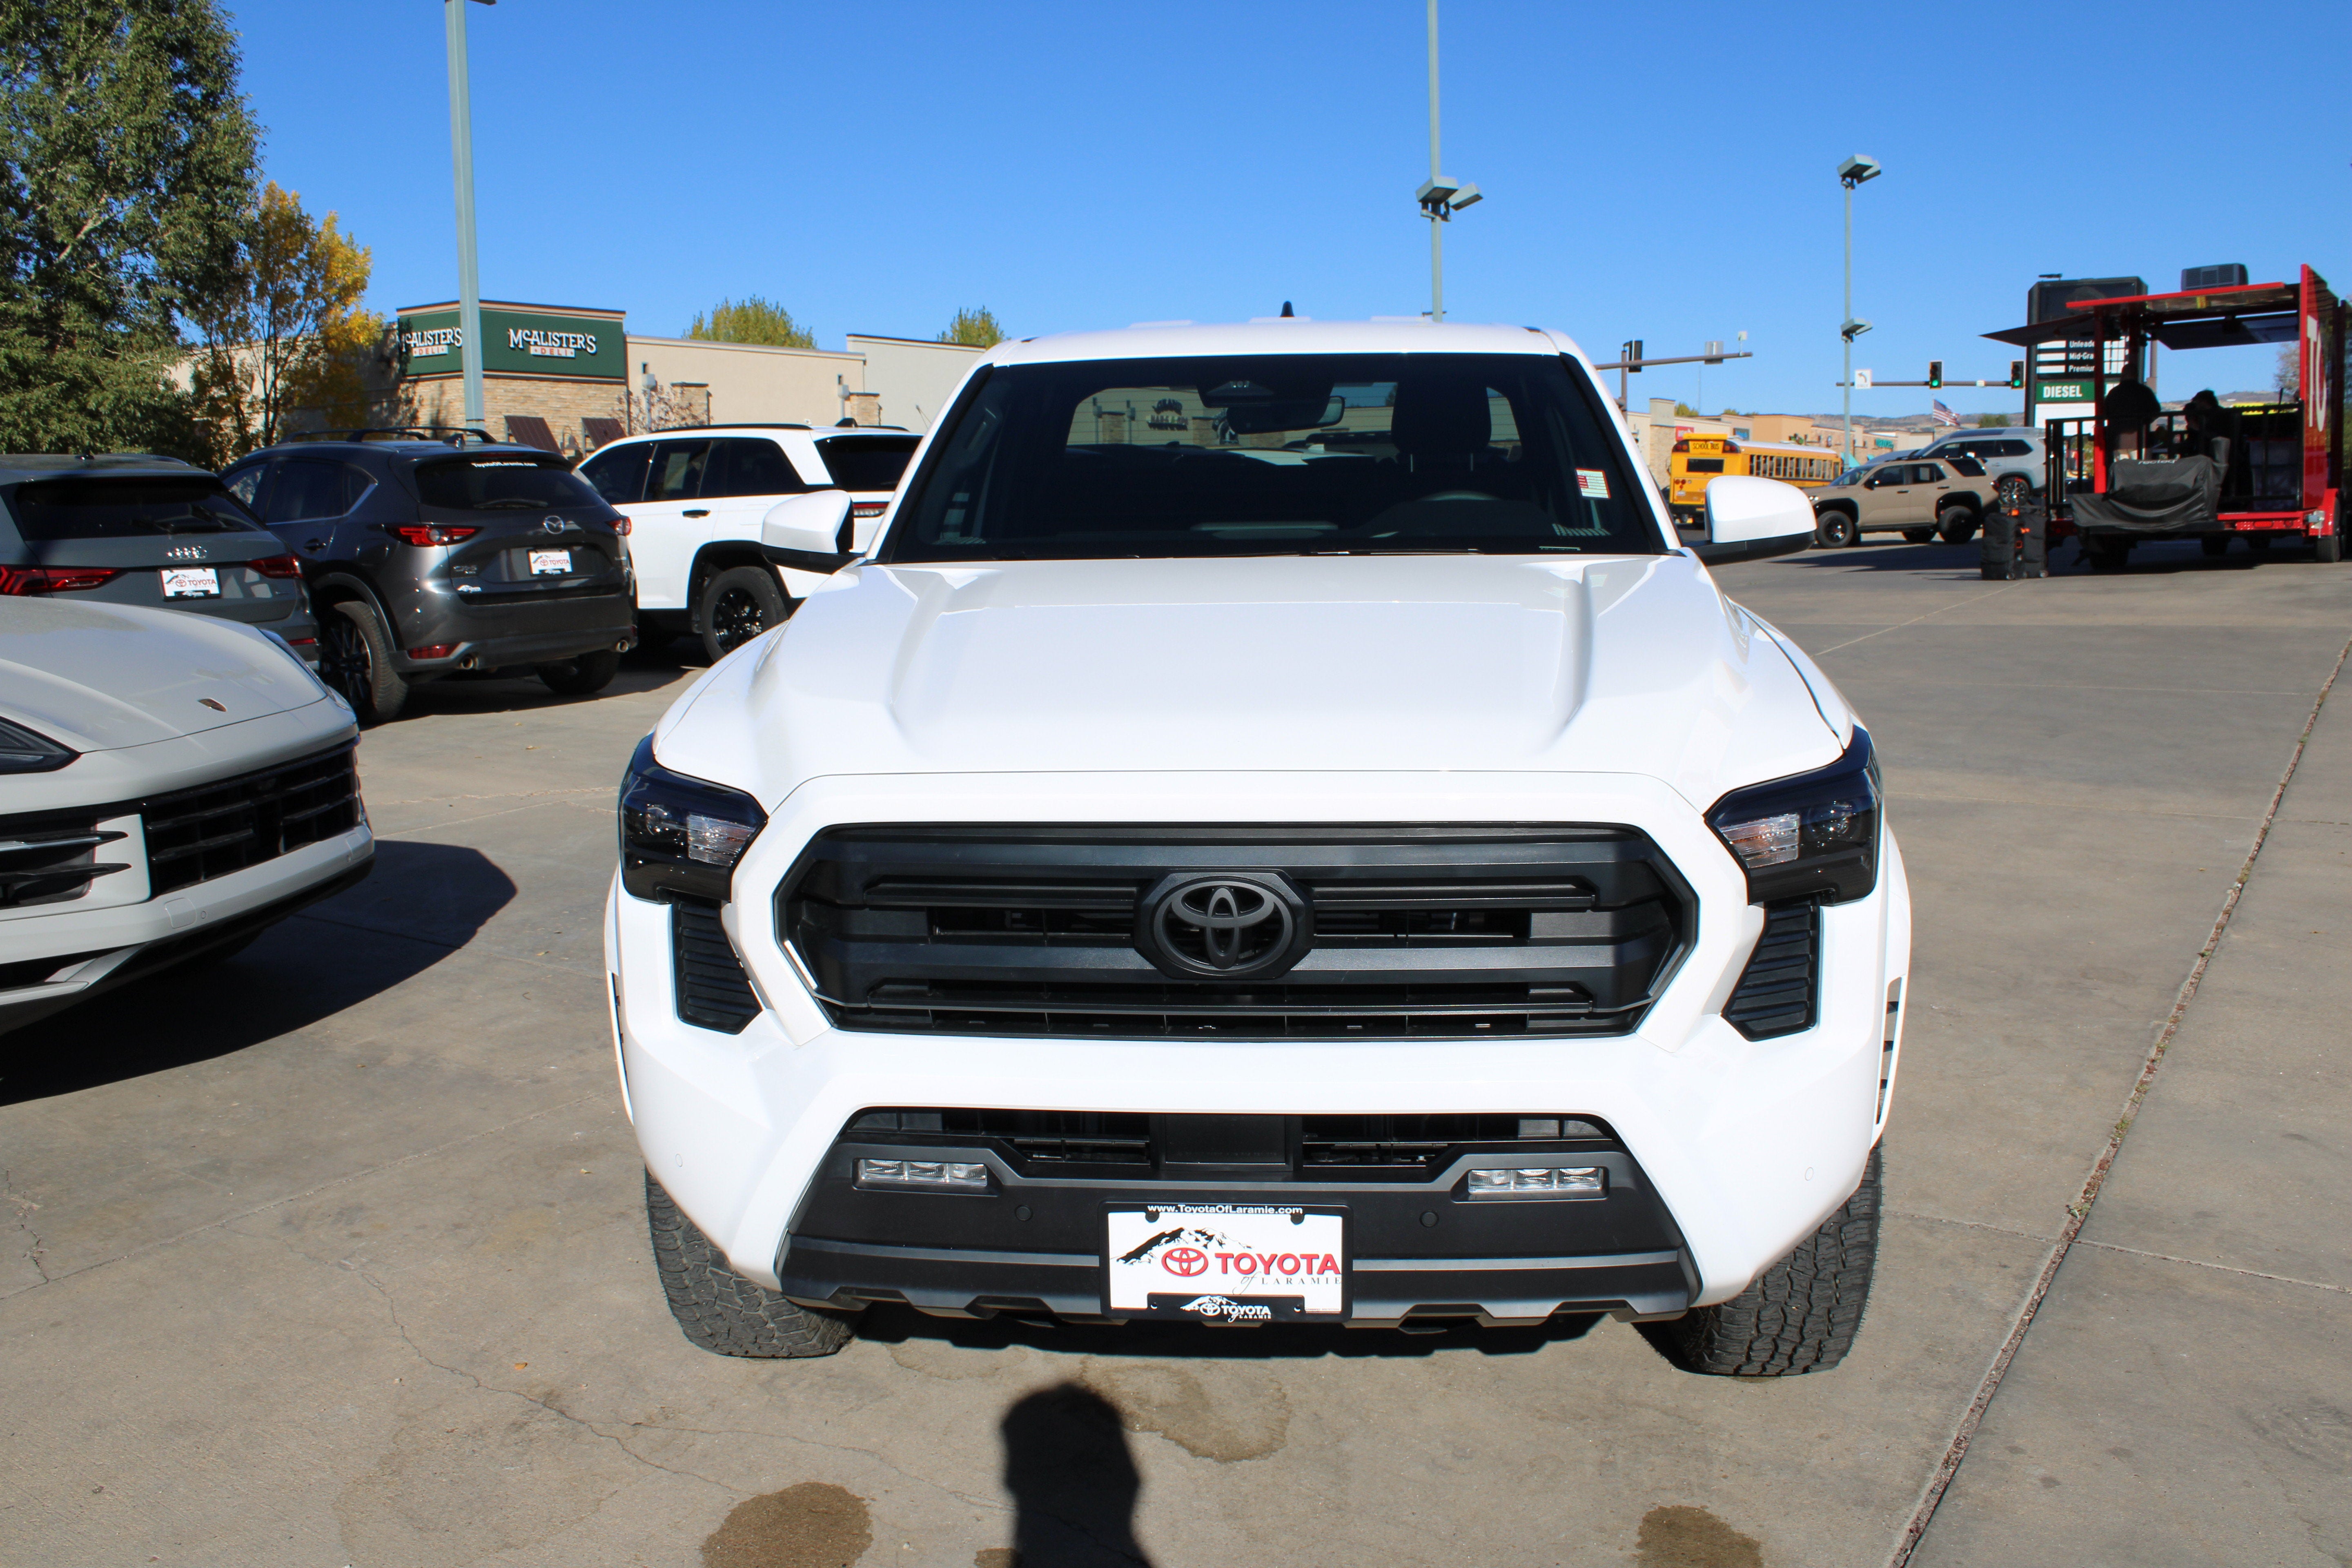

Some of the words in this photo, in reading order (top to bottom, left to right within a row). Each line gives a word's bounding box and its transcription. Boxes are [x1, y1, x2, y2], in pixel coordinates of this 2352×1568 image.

[541, 348, 568, 356] DELI
[2043, 385, 2082, 398] DIESEL
[1147, 1204, 1303, 1215] www.ToyotaOfLaramie.com
[1215, 1252, 1341, 1275] TOYOTA
[1232, 1271, 1262, 1295] of
[1222, 1305, 1271, 1315] TOYOTA
